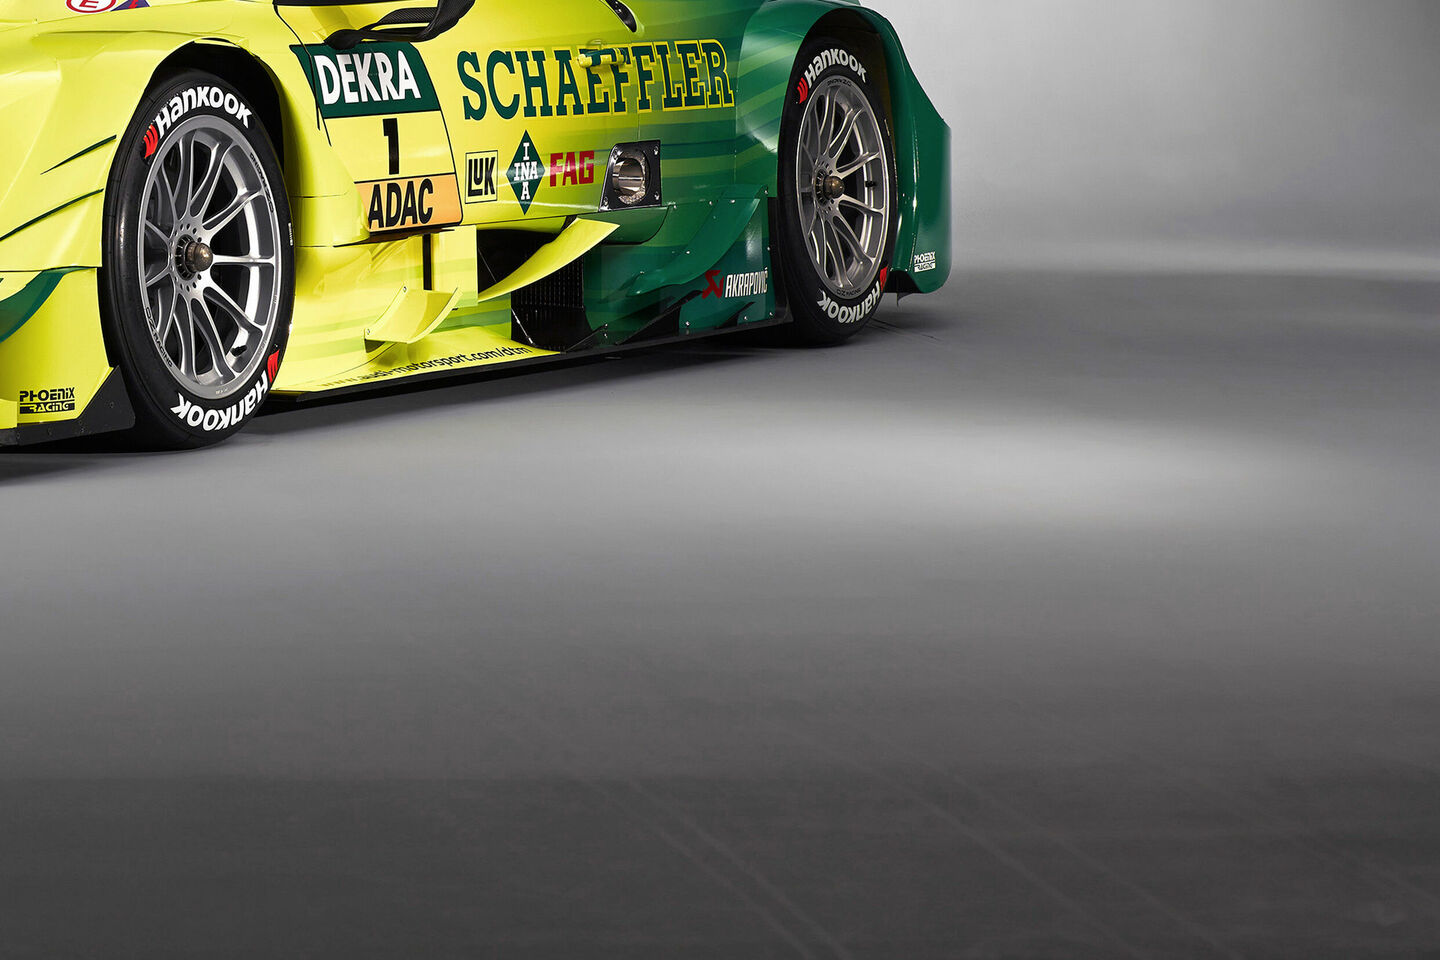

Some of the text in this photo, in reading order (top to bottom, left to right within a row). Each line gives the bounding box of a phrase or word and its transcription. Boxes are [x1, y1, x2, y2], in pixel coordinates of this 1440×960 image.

[314, 50, 422, 105] DEKRA
[456, 39, 736, 121] SCHAEFFLER
[382, 117, 400, 175] 1
[549, 150, 595, 188] FAG
[368, 178, 434, 229] ADAC
